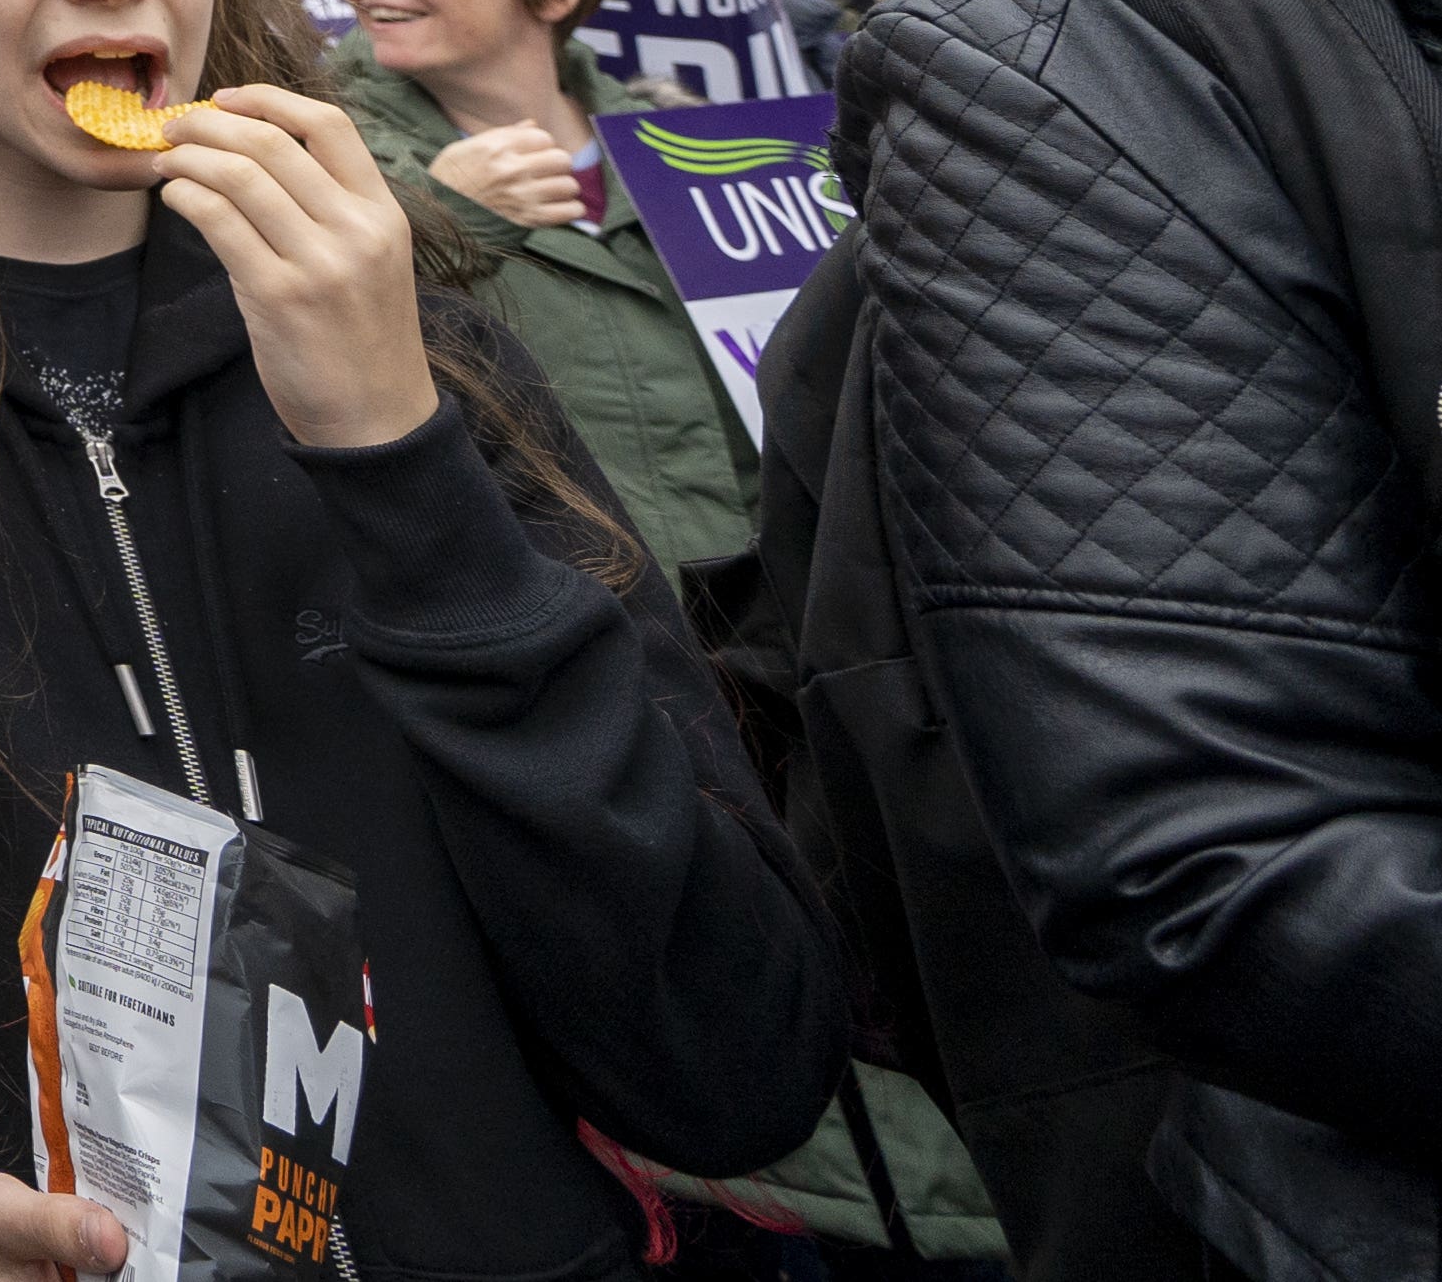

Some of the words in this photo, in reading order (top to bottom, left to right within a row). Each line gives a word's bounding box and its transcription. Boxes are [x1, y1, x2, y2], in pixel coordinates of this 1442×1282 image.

[93, 849, 113, 863] Energy
[167, 843, 200, 863] VALUES
[77, 979, 104, 998] SUITABLE
[103, 988, 118, 1003] FOR
[117, 993, 177, 1027] VEGETARIANS
[259, 1146, 338, 1217] PUNCHY
